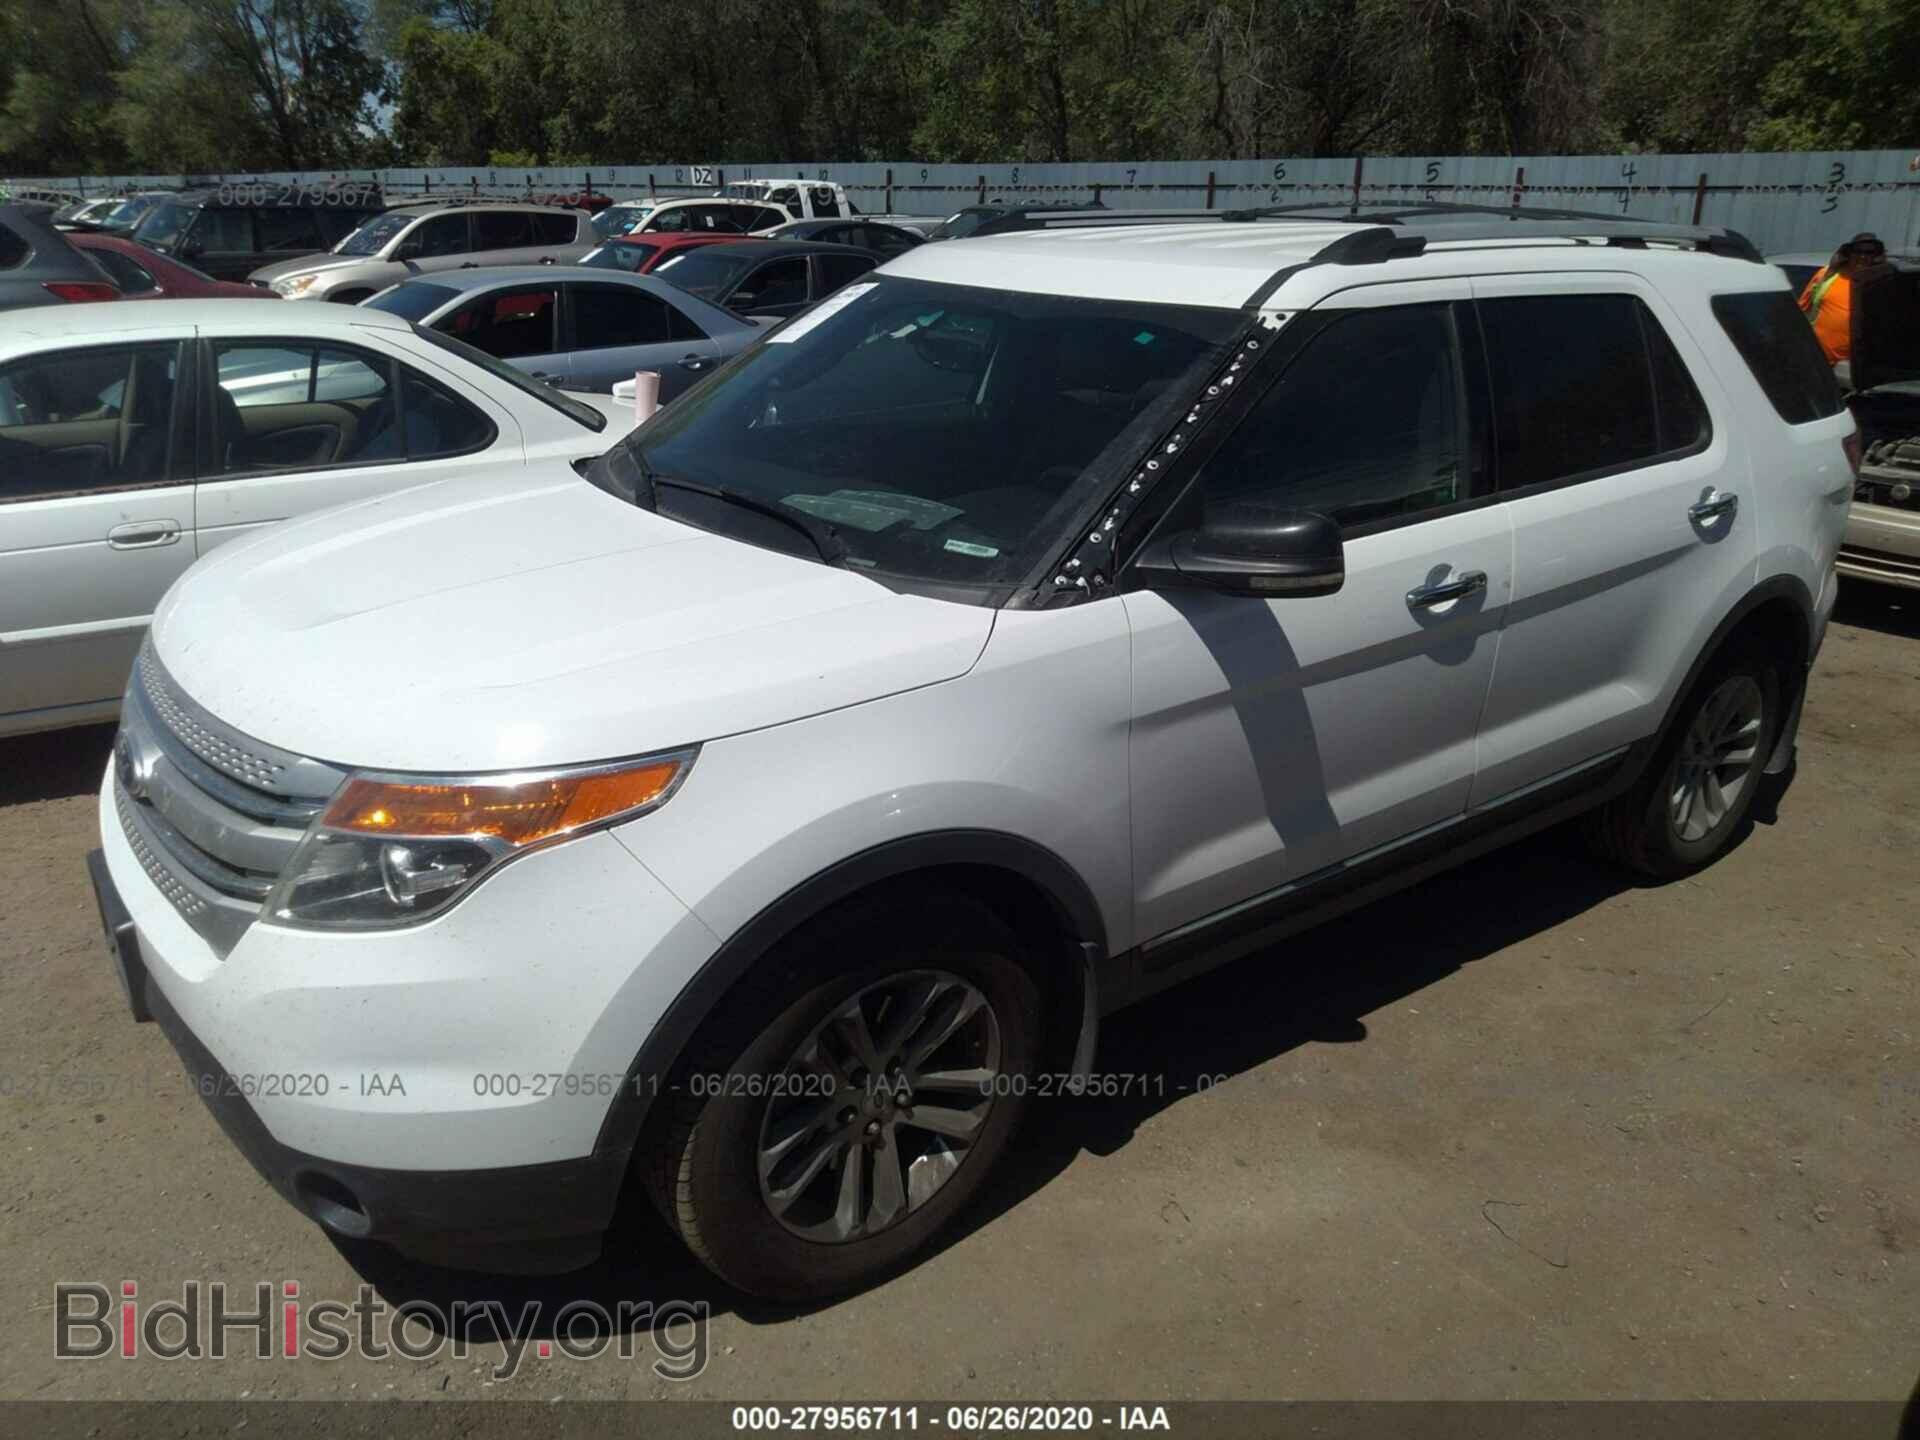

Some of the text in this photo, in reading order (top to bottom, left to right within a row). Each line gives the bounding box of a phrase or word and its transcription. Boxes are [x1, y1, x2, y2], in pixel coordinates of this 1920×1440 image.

[920, 169, 928, 183] 9
[1011, 168, 1020, 183] 8
[1126, 169, 1137, 183] 7
[1273, 162, 1286, 180] 6
[1426, 162, 1441, 182] 5
[1622, 162, 1637, 183] 4
[1829, 162, 1846, 184] 3
